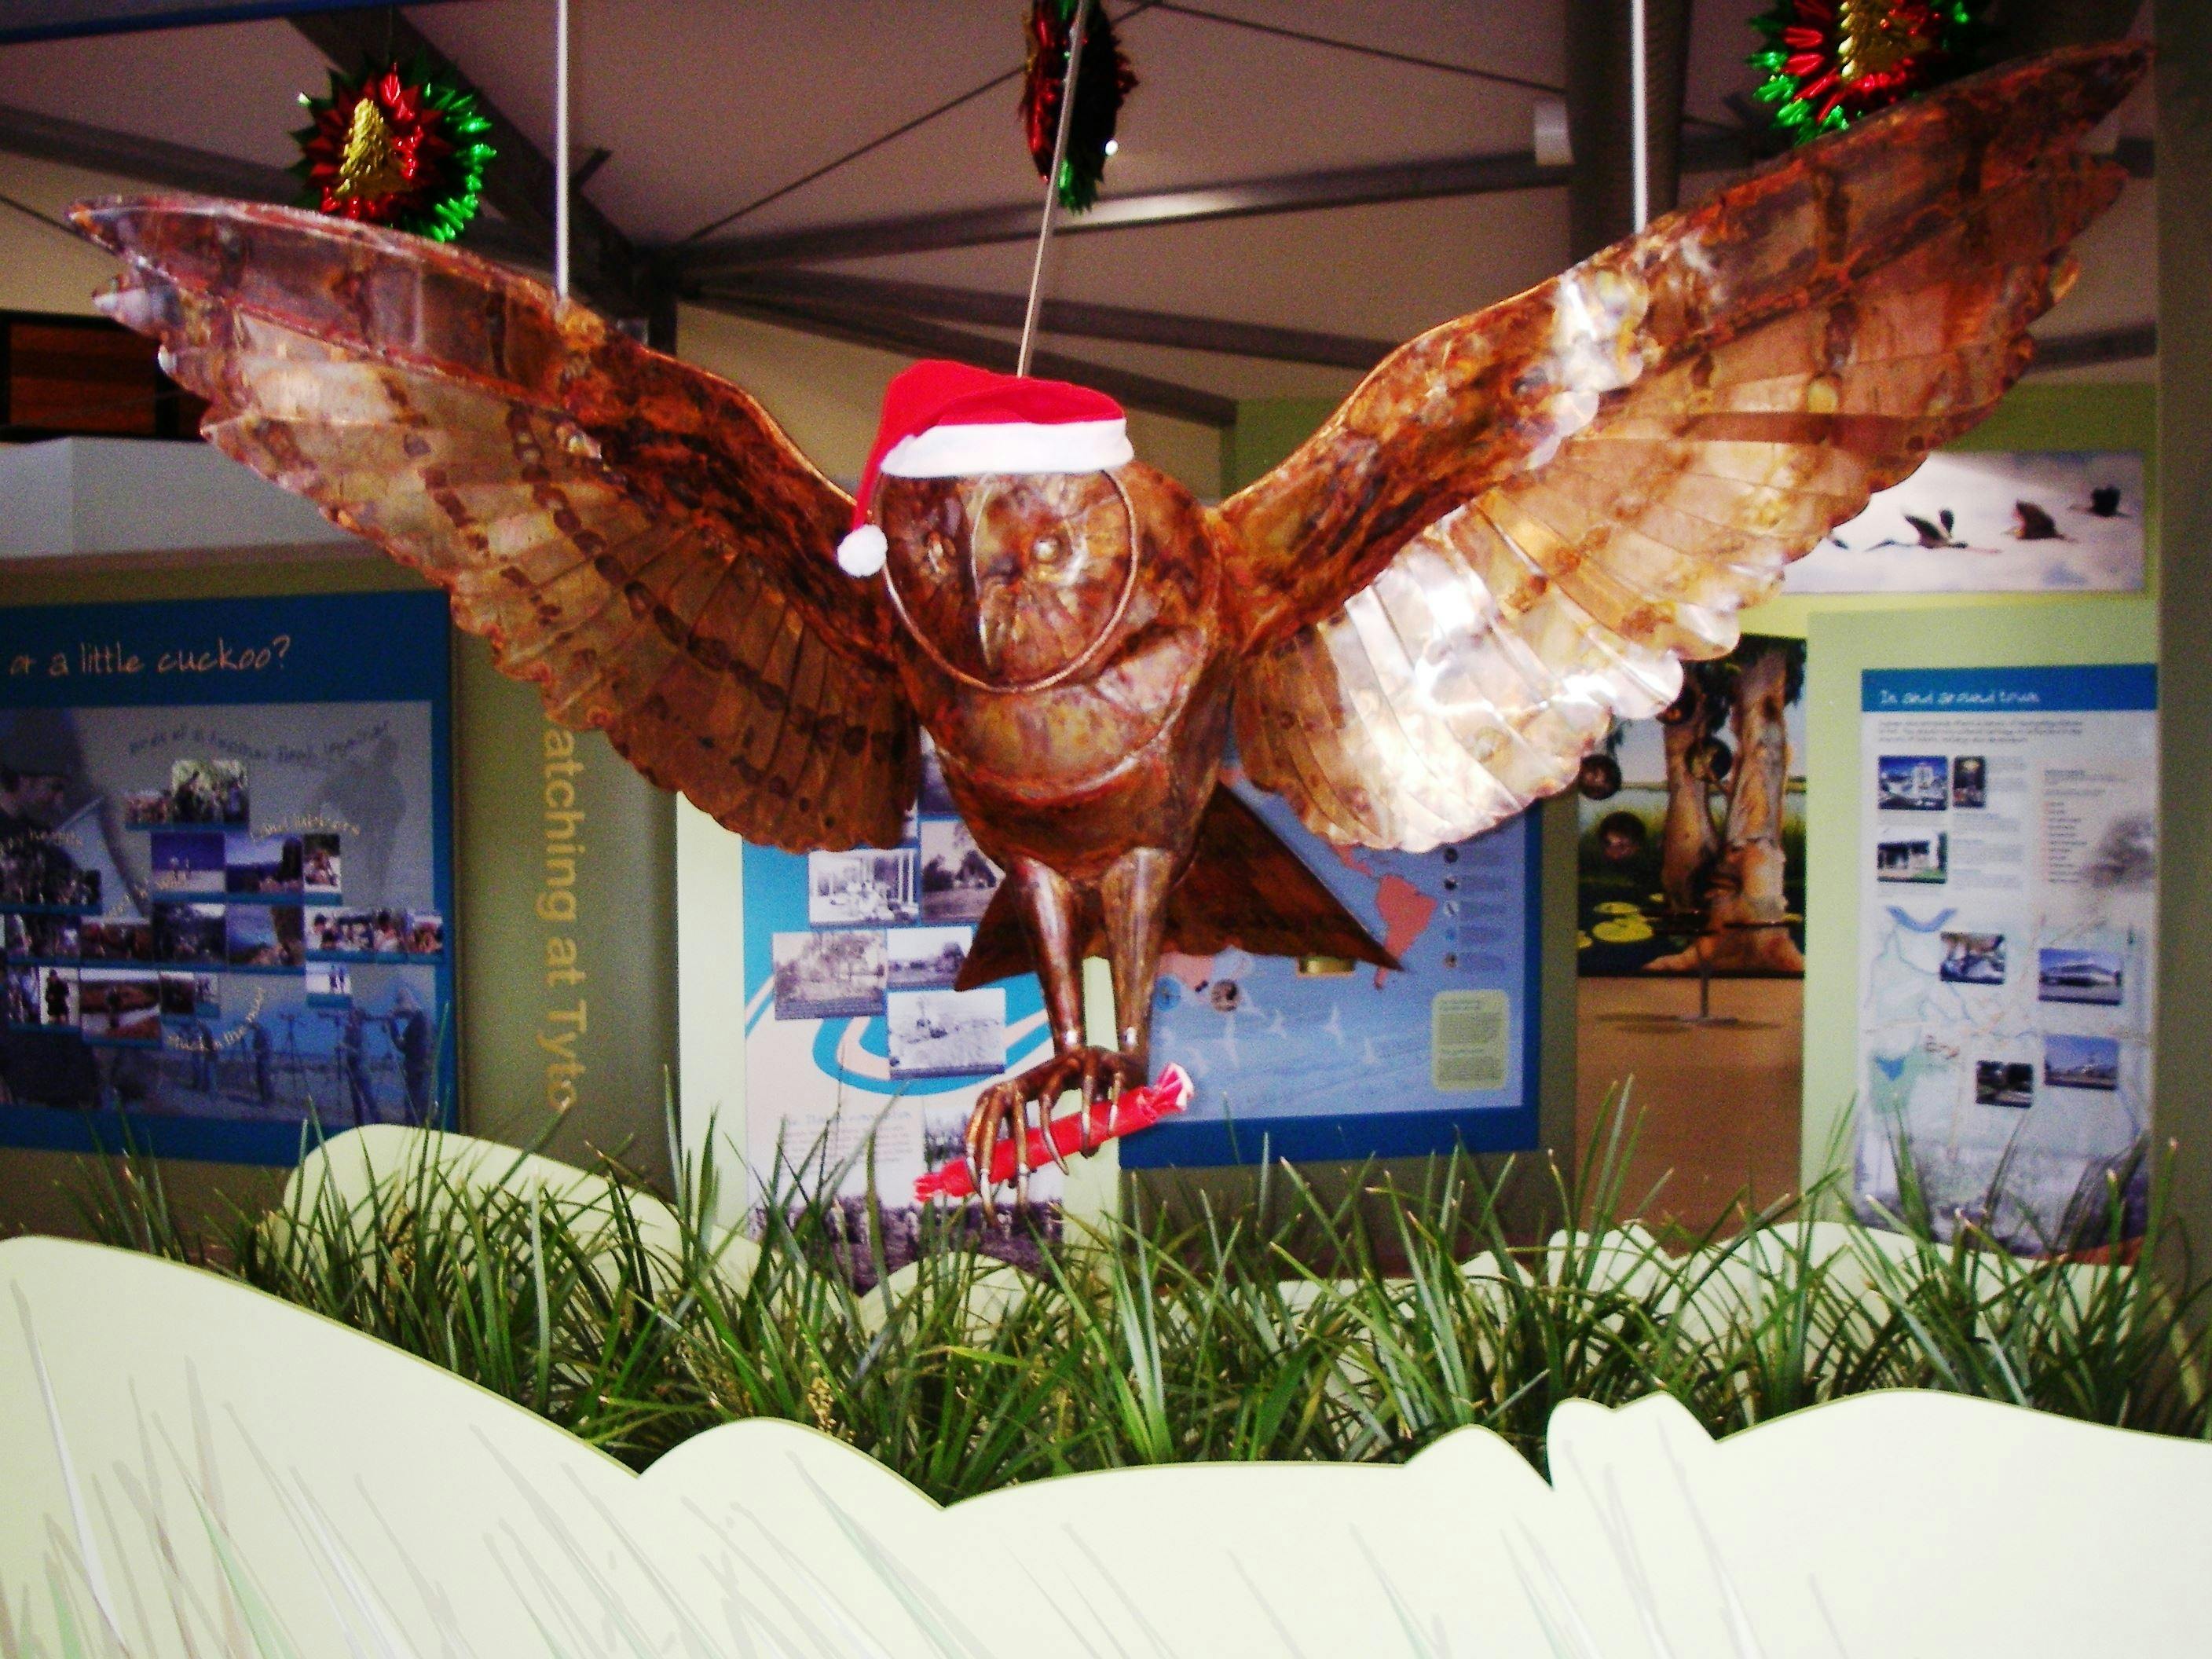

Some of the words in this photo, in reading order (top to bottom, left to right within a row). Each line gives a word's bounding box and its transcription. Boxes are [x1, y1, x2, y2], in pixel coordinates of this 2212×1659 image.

[9, 654, 36, 676] or
[49, 653, 69, 677] a
[80, 640, 145, 676] little
[157, 635, 291, 673] cuckoo?
[533, 727, 587, 921] atching
[545, 936, 588, 987] at
[535, 999, 588, 1113] Tyto
